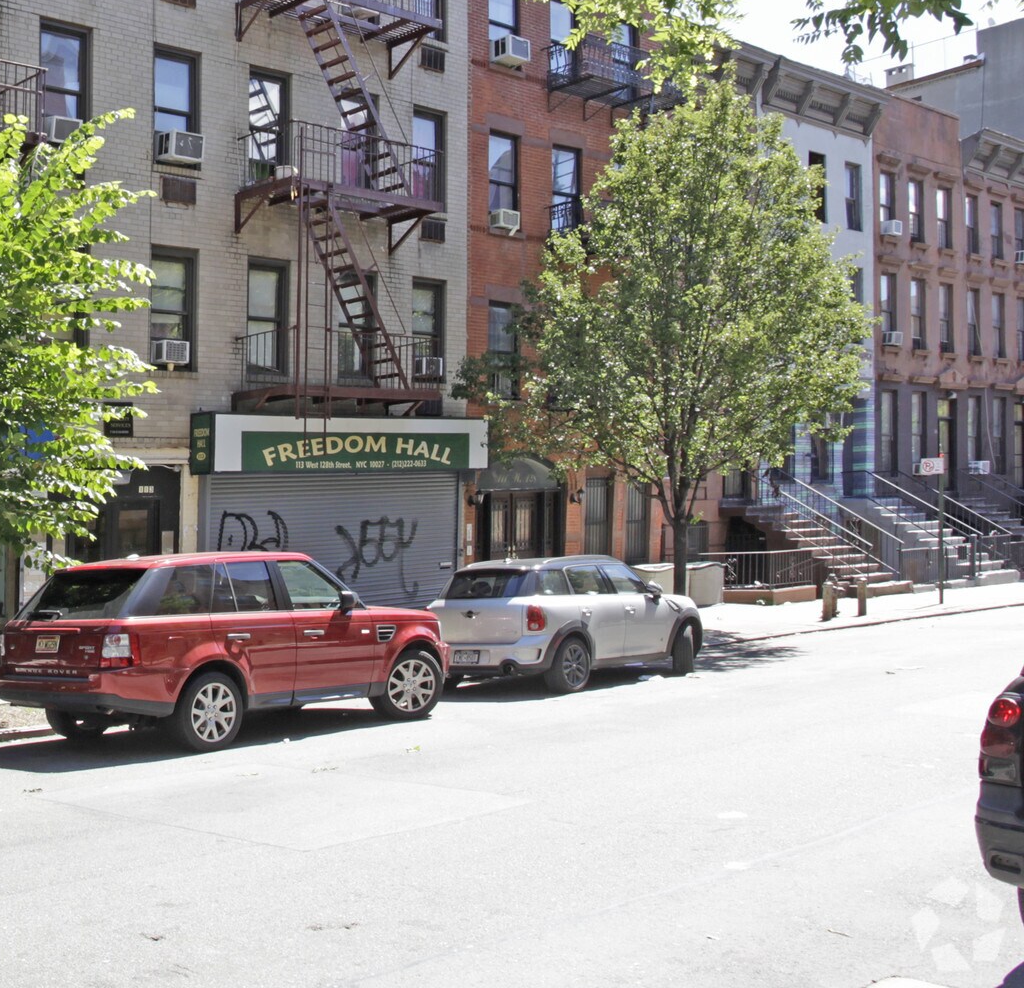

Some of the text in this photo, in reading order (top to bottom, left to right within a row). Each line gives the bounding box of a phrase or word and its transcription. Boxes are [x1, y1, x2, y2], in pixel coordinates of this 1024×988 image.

[262, 435, 451, 466] FREEDOM HALL
[305, 460, 319, 468] West
[355, 460, 368, 468] NYC
